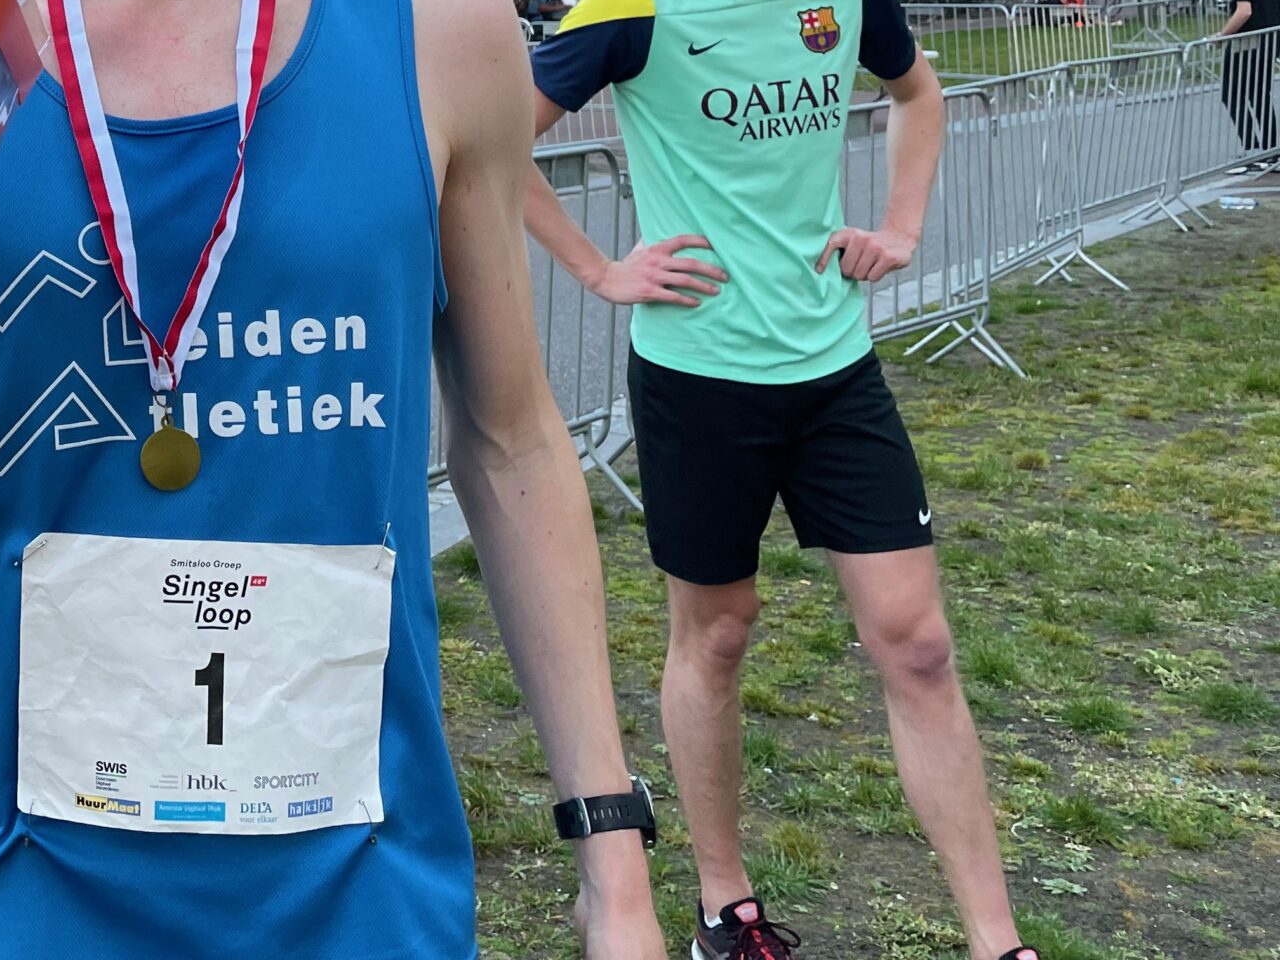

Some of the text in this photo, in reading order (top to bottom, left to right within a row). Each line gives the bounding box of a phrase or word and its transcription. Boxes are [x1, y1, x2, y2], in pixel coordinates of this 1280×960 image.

[701, 73, 841, 127] QATAR
[738, 107, 841, 142] AIRWAYS
[213, 560, 242, 570] Groep
[162, 574, 249, 602] Singel
[195, 600, 252, 630] loop
[195, 652, 225, 745] 1
[96, 760, 127, 775] SWIS
[253, 772, 319, 789] SPORTCITY
[240, 801, 272, 814] DELA
